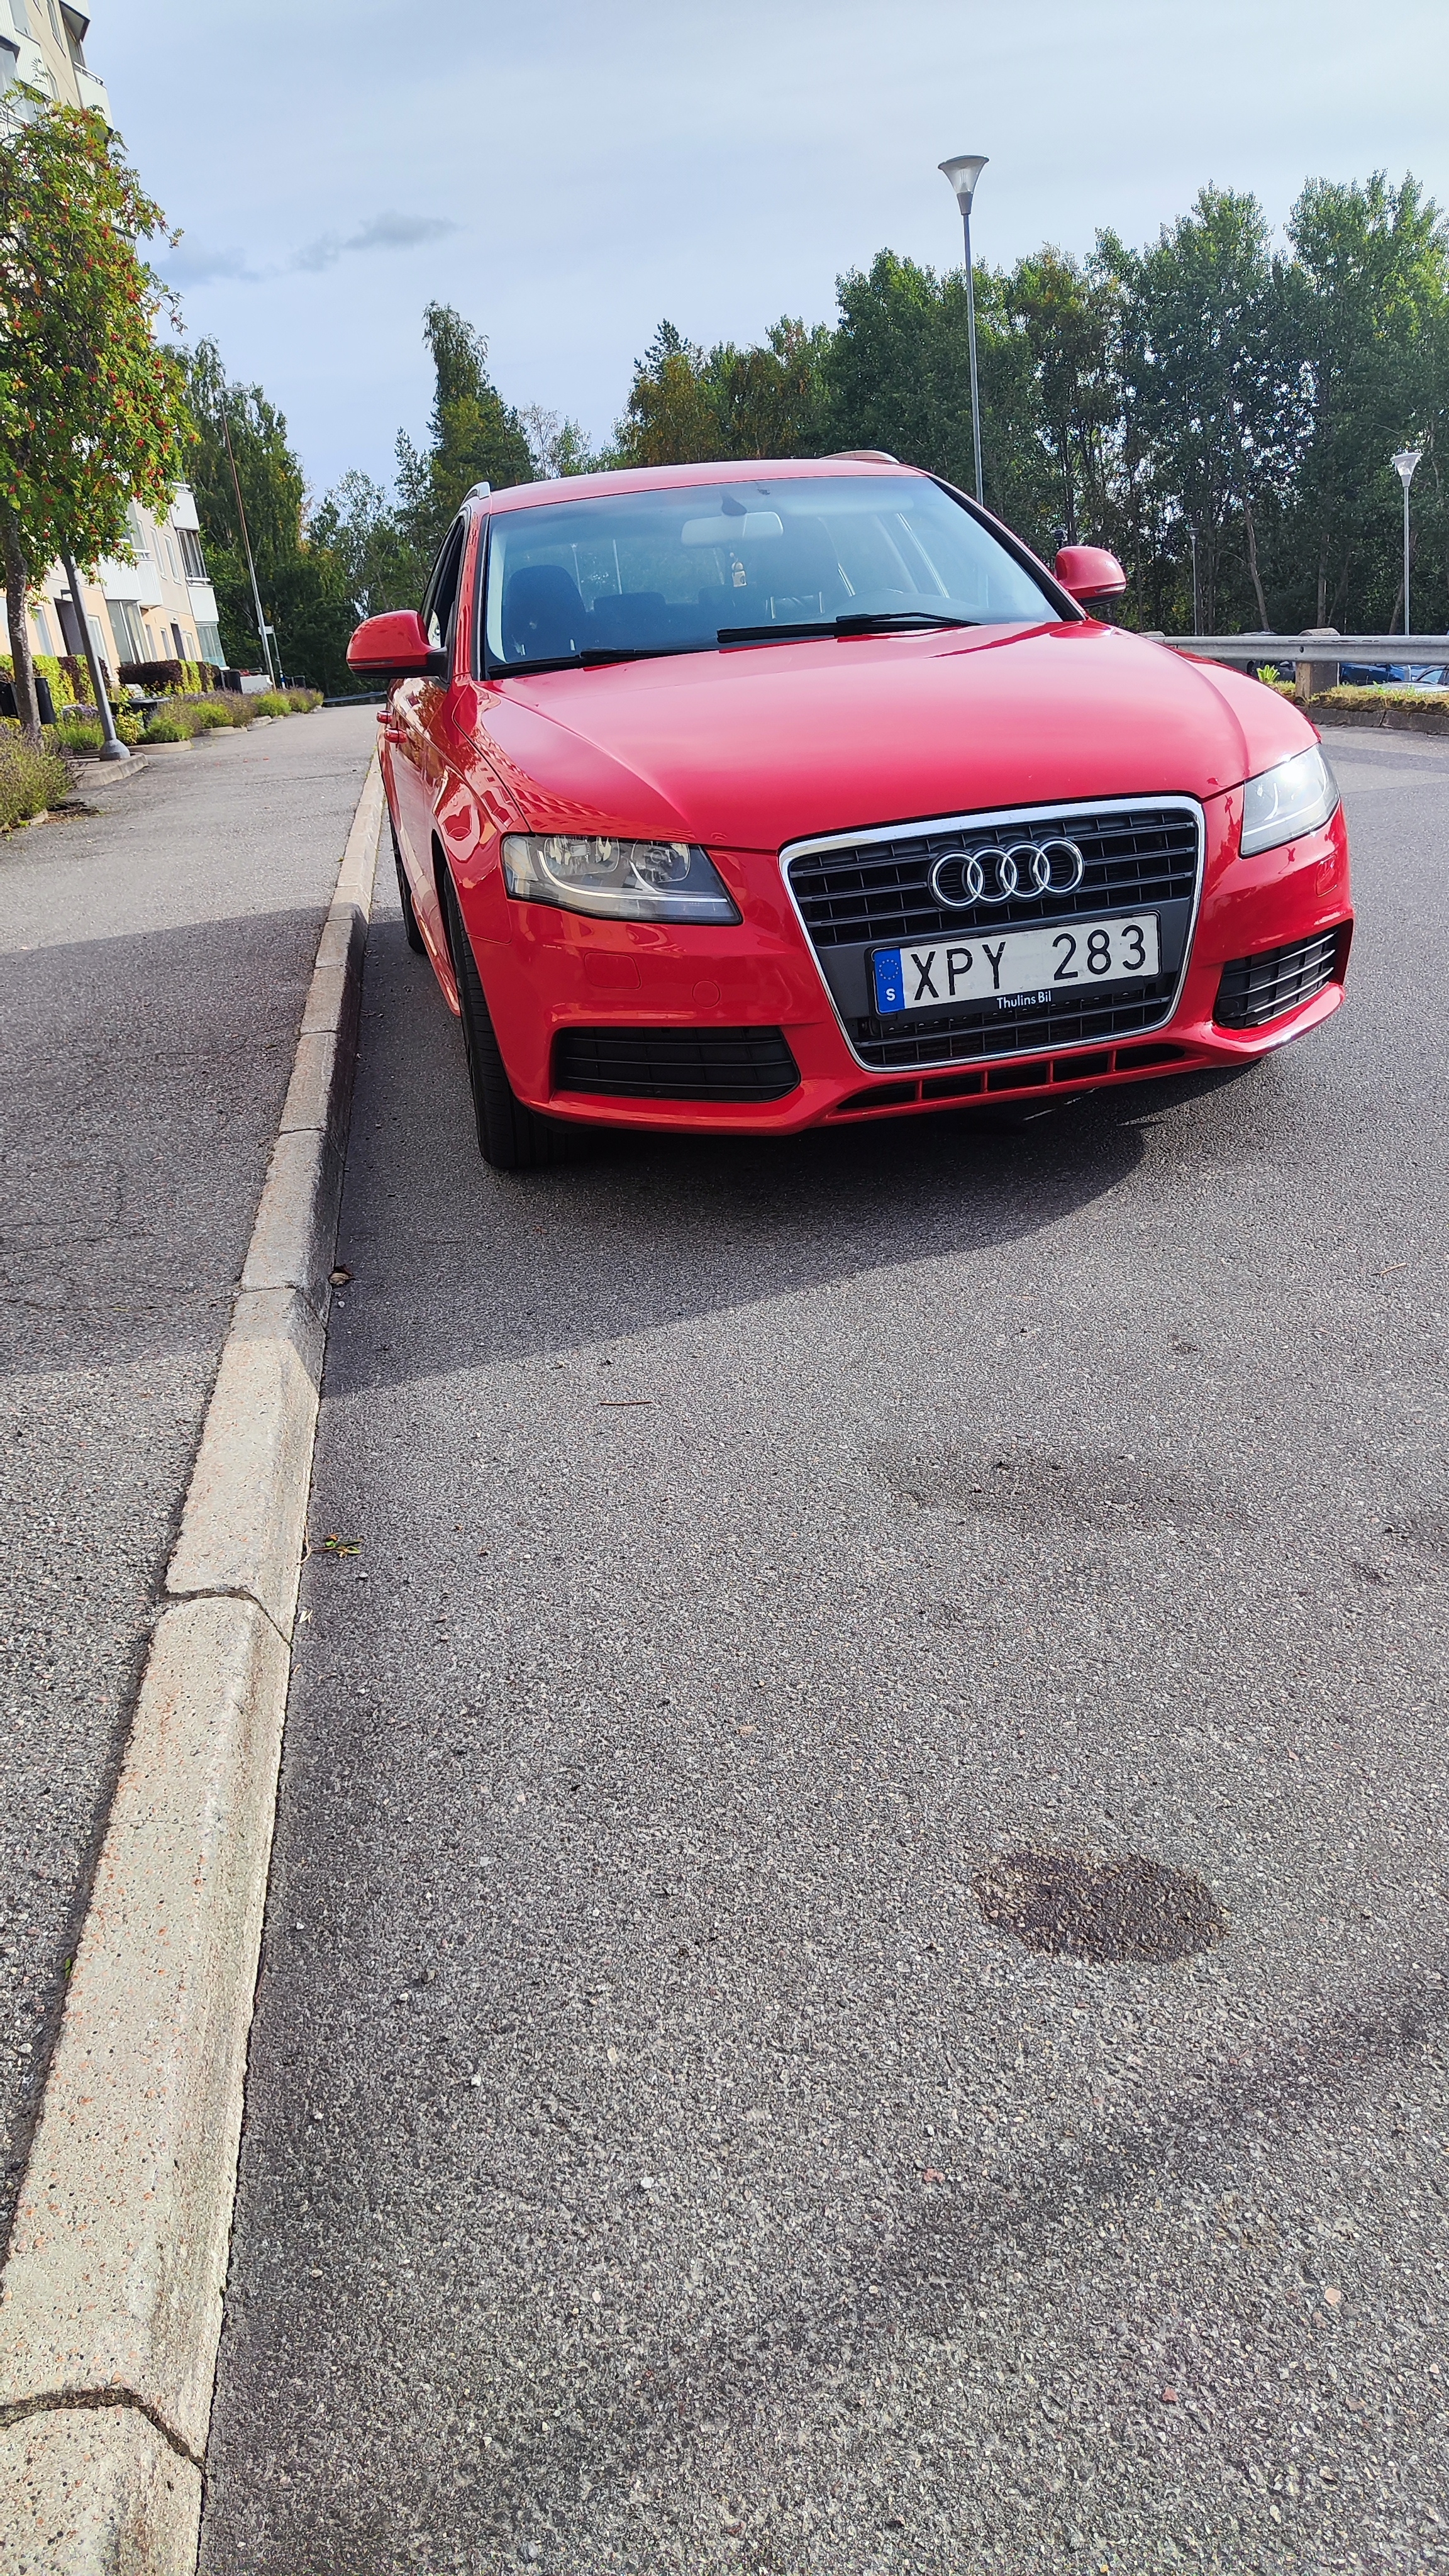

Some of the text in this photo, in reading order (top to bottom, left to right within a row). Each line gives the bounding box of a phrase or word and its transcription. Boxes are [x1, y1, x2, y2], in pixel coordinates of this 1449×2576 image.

[911, 924, 1146, 1001] XPY 283
[886, 988, 896, 1001] S
[996, 991, 1052, 1009] Thulins Bil
